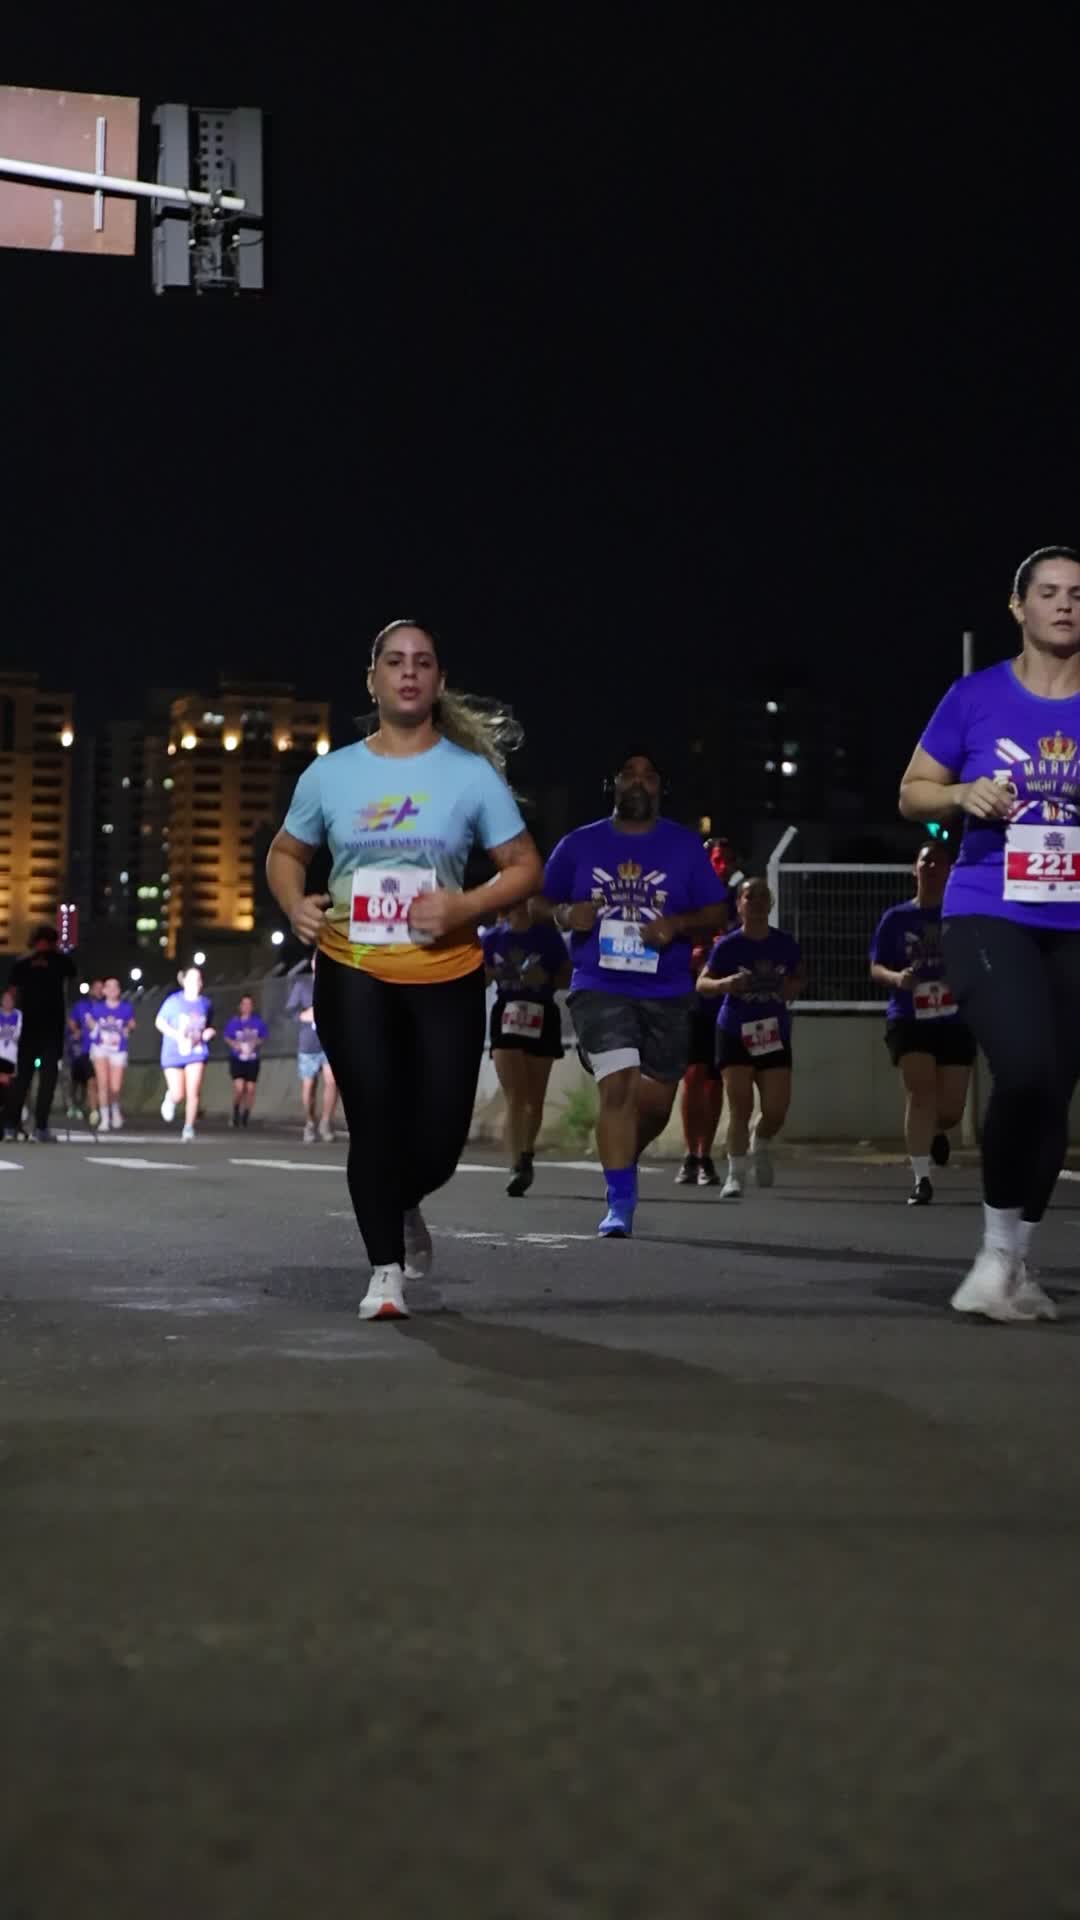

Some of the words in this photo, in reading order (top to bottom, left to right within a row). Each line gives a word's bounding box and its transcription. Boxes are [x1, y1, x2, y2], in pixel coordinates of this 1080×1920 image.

[1026, 780, 1057, 793] NIGHT
[1026, 853, 1076, 875] 221
[367, 897, 413, 919] 607
